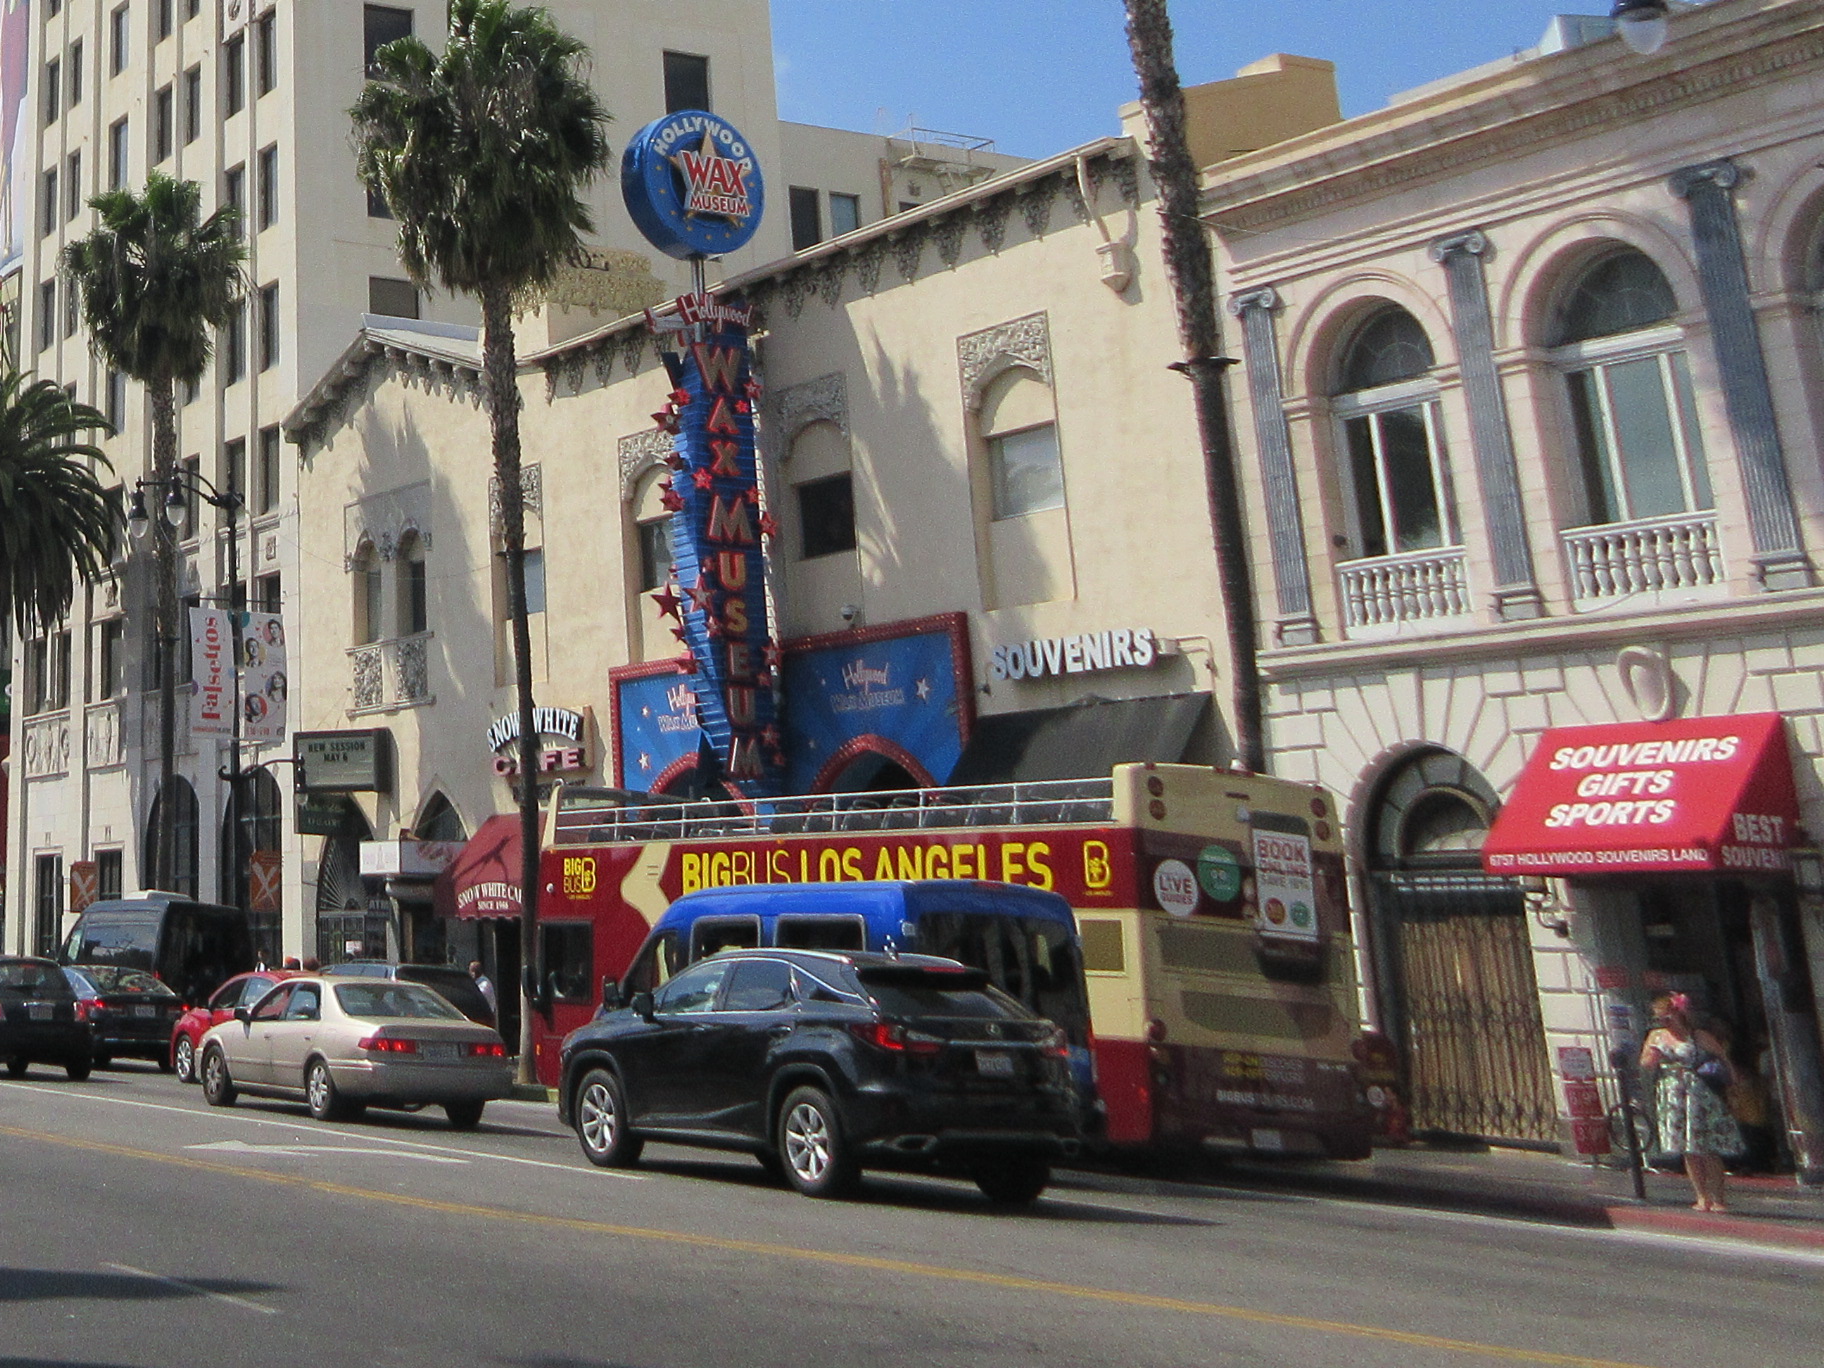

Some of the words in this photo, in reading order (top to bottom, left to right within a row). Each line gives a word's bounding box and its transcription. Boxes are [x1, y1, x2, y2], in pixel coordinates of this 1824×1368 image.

[652, 116, 754, 172] HOLLYWOOD
[680, 150, 748, 199] WAX
[688, 192, 750, 217] MUSEUM
[677, 292, 753, 333] Hollywood
[691, 342, 743, 476] WAX
[707, 494, 764, 780] MUSEUM
[202, 616, 223, 720] Falsettos
[990, 627, 1156, 681] SOUVENIRS
[487, 710, 520, 753] SNOW
[532, 707, 579, 741] WHITE
[323, 753, 340, 762] MAY
[330, 740, 365, 751] SESSION
[1548, 736, 1741, 771] SOUVENIRS
[492, 748, 580, 777] CFE
[1577, 769, 1676, 798] GIFTS
[1544, 799, 1678, 828] SPORTS
[1732, 813, 1785, 844] BEST
[1257, 838, 1307, 864] BOOK
[1517, 850, 1594, 866] HOLLYWOOD
[1596, 848, 1670, 864] SOUVENIRS
[1672, 847, 1708, 862] LAND
[563, 857, 582, 876] BIG
[799, 847, 864, 883] LOS
[875, 841, 1054, 891] ANGELES
[457, 884, 480, 909] SNOW
[481, 882, 507, 899] WHITE
[563, 875, 582, 893] BUS
[1159, 874, 1193, 895] LIVE
[477, 900, 493, 910] SINCE
